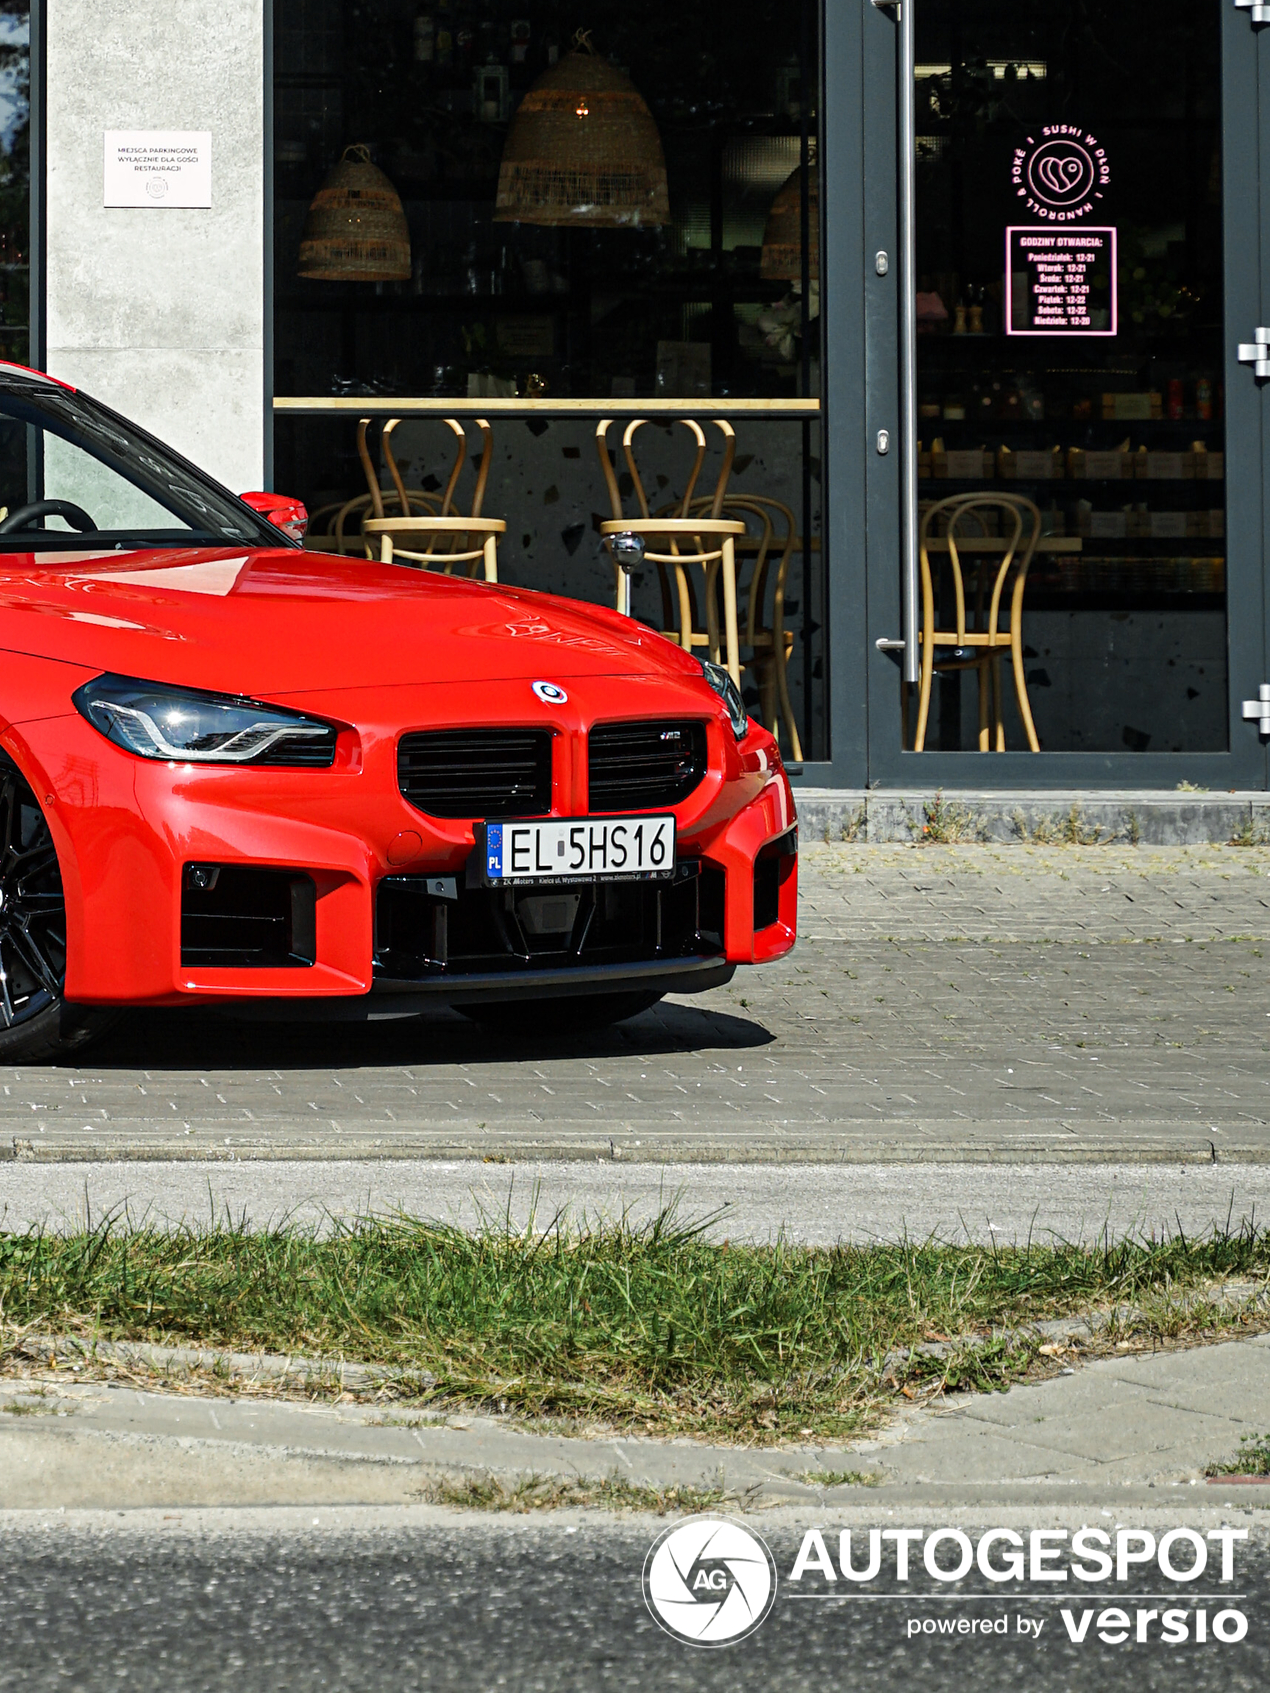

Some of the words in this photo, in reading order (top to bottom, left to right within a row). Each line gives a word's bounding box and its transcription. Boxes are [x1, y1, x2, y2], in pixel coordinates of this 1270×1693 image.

[1042, 124, 1082, 137] SUSHI
[1084, 134, 1097, 146] W
[177, 155, 199, 163] GOŚCI
[1026, 198, 1093, 221] HANDROLL
[1020, 237, 1056, 247] GODZINY
[1056, 237, 1103, 247] OTWARCIA:
[1075, 253, 1095, 262] 12-21
[1067, 263, 1086, 272] 12-21
[1064, 274, 1084, 283] 12-21
[1070, 285, 1090, 294] 12-21
[511, 828, 553, 872] EL
[569, 823, 666, 870] 5HS16
[488, 856, 501, 870] PL
